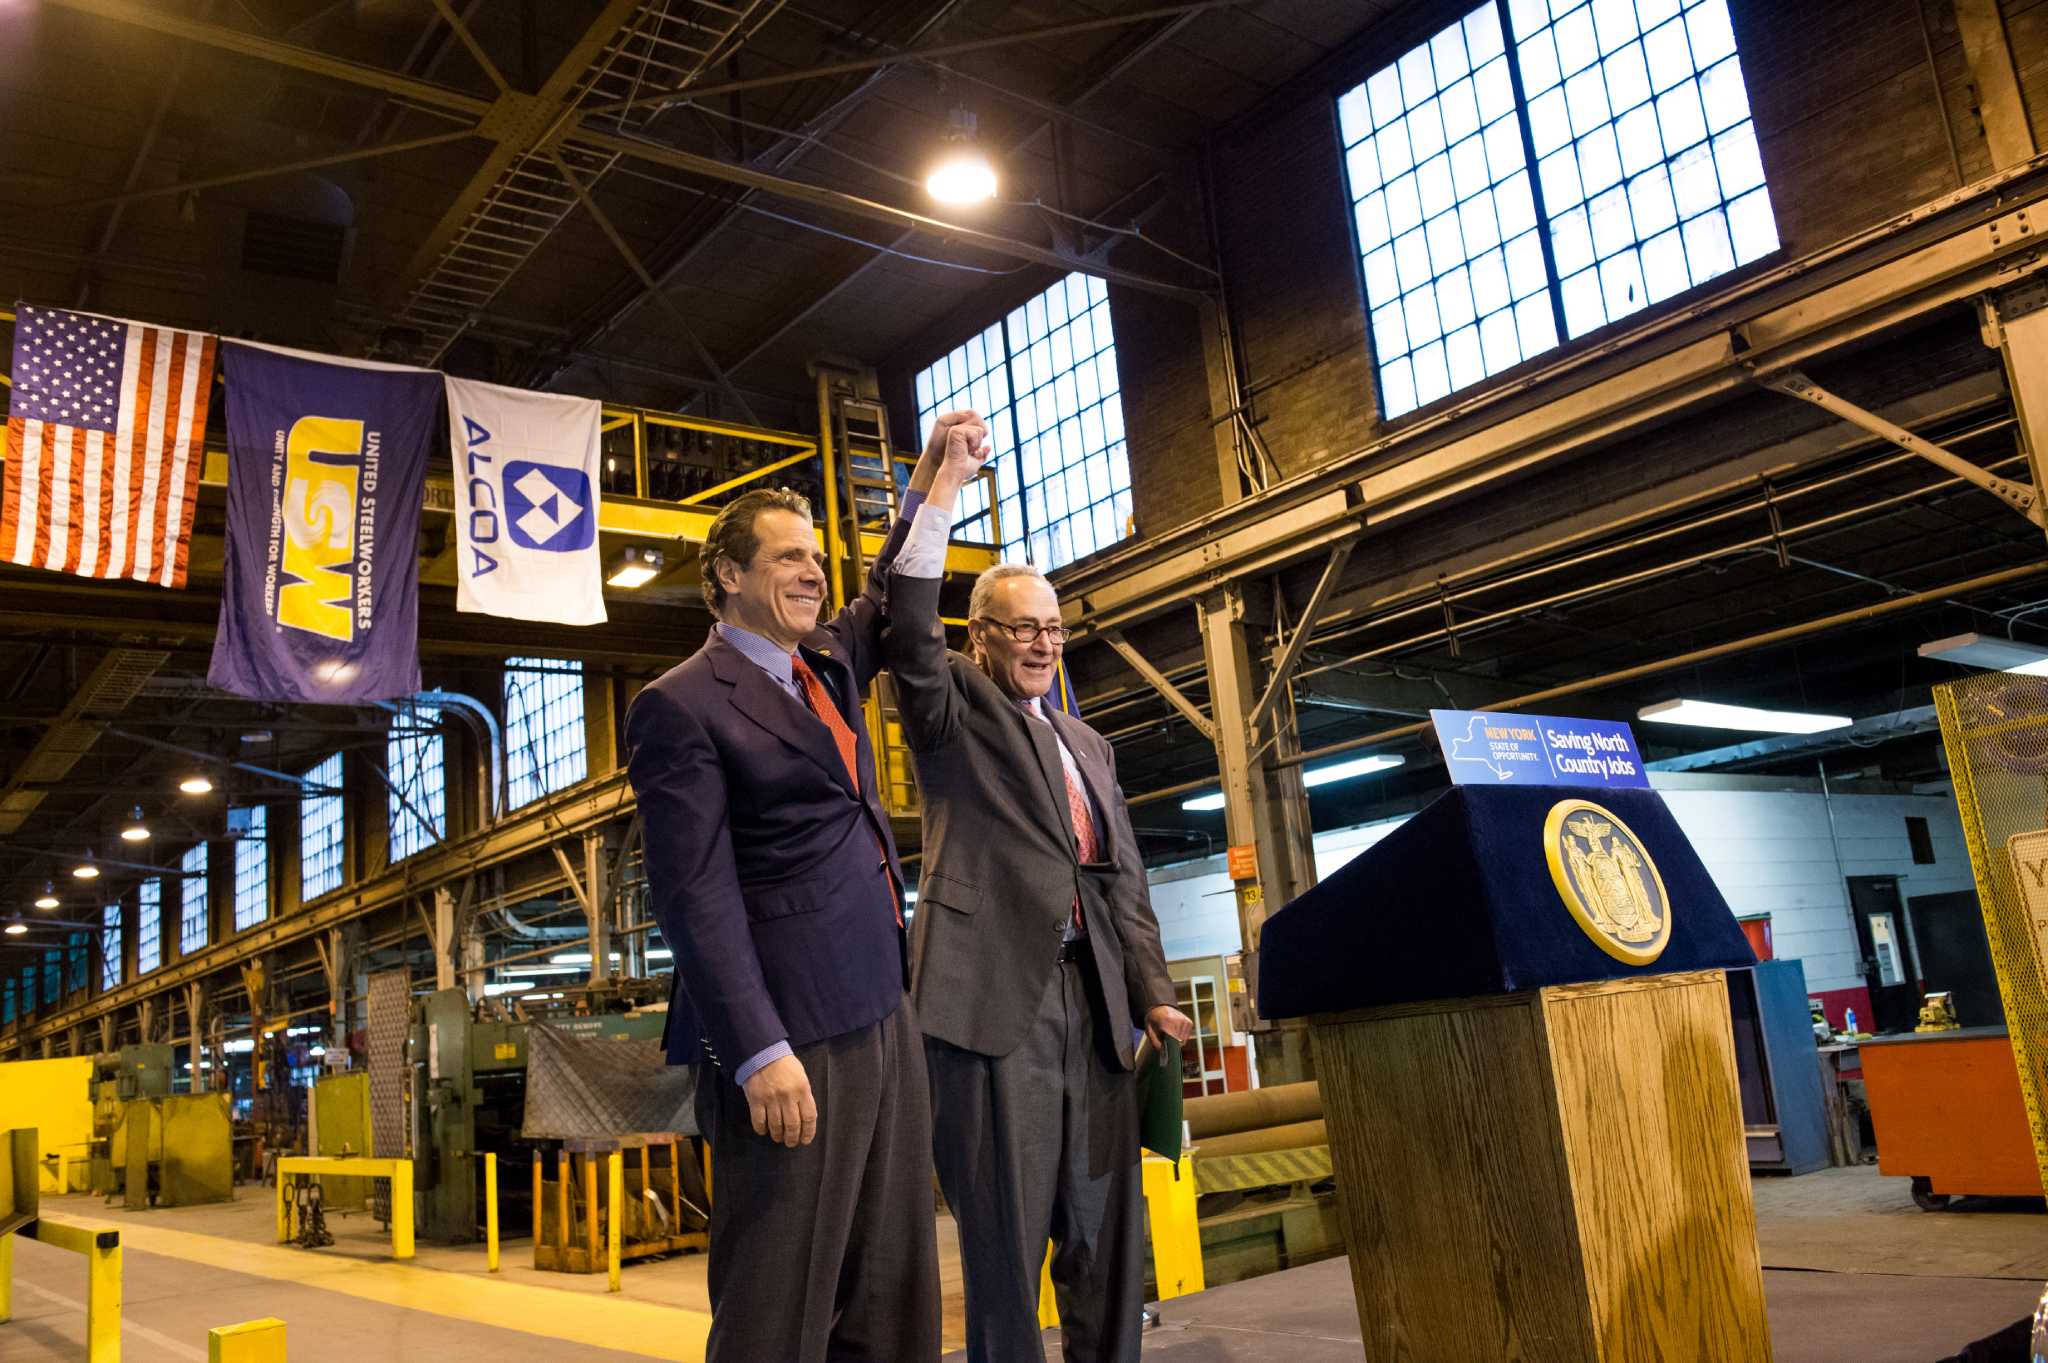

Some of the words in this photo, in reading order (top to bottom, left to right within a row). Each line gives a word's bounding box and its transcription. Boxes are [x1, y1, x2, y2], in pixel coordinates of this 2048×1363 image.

[273, 429, 285, 462] UNITY
[363, 430, 380, 492] UNITED
[271, 463, 282, 487] AND
[462, 413, 498, 578] ALCOA
[276, 415, 364, 642] USW
[268, 539, 279, 561] FOR
[357, 497, 376, 629] STEELWORKERS
[1484, 727, 1508, 740] NEW
[1488, 742, 1508, 751] STATE
[1510, 742, 1519, 751] OF
[1547, 729, 1596, 756] Saving
[1591, 732, 1630, 753] North
[1556, 753, 1608, 780] Country
[1606, 755, 1636, 776] Jobs
